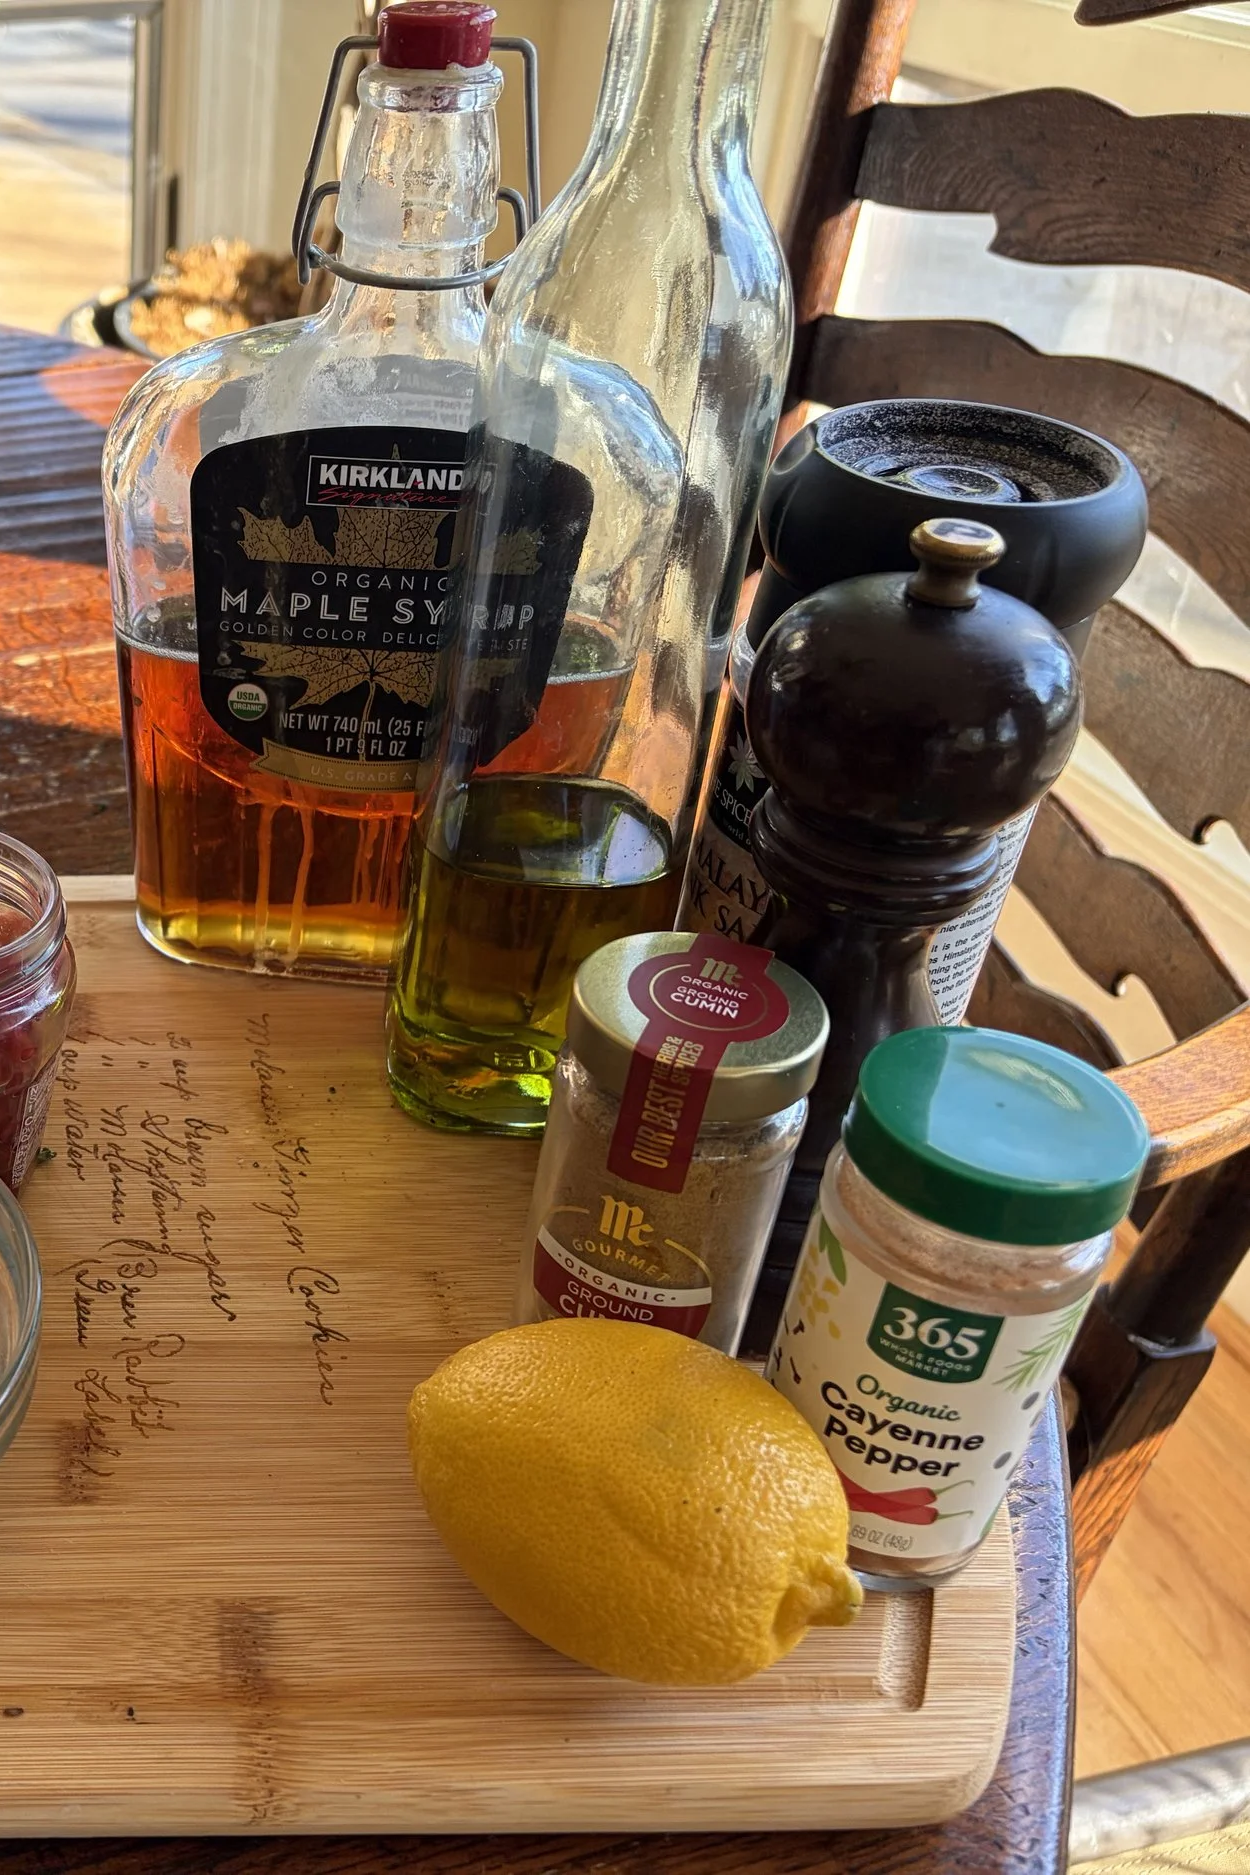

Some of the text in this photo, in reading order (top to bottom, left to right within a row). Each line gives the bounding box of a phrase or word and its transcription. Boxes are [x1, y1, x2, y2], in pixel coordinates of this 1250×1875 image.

[318, 463, 464, 491] KIRKLAND
[317, 486, 464, 508] Signature
[220, 586, 370, 623] MAPLE
[219, 620, 294, 638] GOLDEN
[302, 627, 367, 643] COLOR
[233, 702, 263, 713] ORGANIC
[236, 690, 260, 702] USDA
[278, 712, 304, 730] NET
[307, 714, 330, 732] WT
[333, 716, 359, 734] 740
[363, 719, 383, 736] mL
[387, 717, 412, 738] (25
[325, 736, 407, 757] 1 PT 9 FL OZ
[310, 765, 413, 782] U.S. GRADE A
[676, 985, 740, 1009] GROUND
[680, 975, 749, 1000] ORGANIC
[670, 992, 739, 1019] CUMIN
[631, 1078, 687, 1170] OUR BEST
[170, 1205, 237, 1322] sugar
[571, 1238, 671, 1283] GOURMET
[564, 1256, 667, 1304] ORGANIC
[567, 1279, 655, 1323] GROUND
[287, 1267, 350, 1407] Cookies
[882, 1305, 987, 1361] 365
[879, 1337, 973, 1373] WHOLE FOODS
[894, 1353, 949, 1377] MARKET
[855, 1373, 962, 1423] Organic
[820, 1379, 985, 1452] Cayenne
[823, 1413, 960, 1477] Pepper
